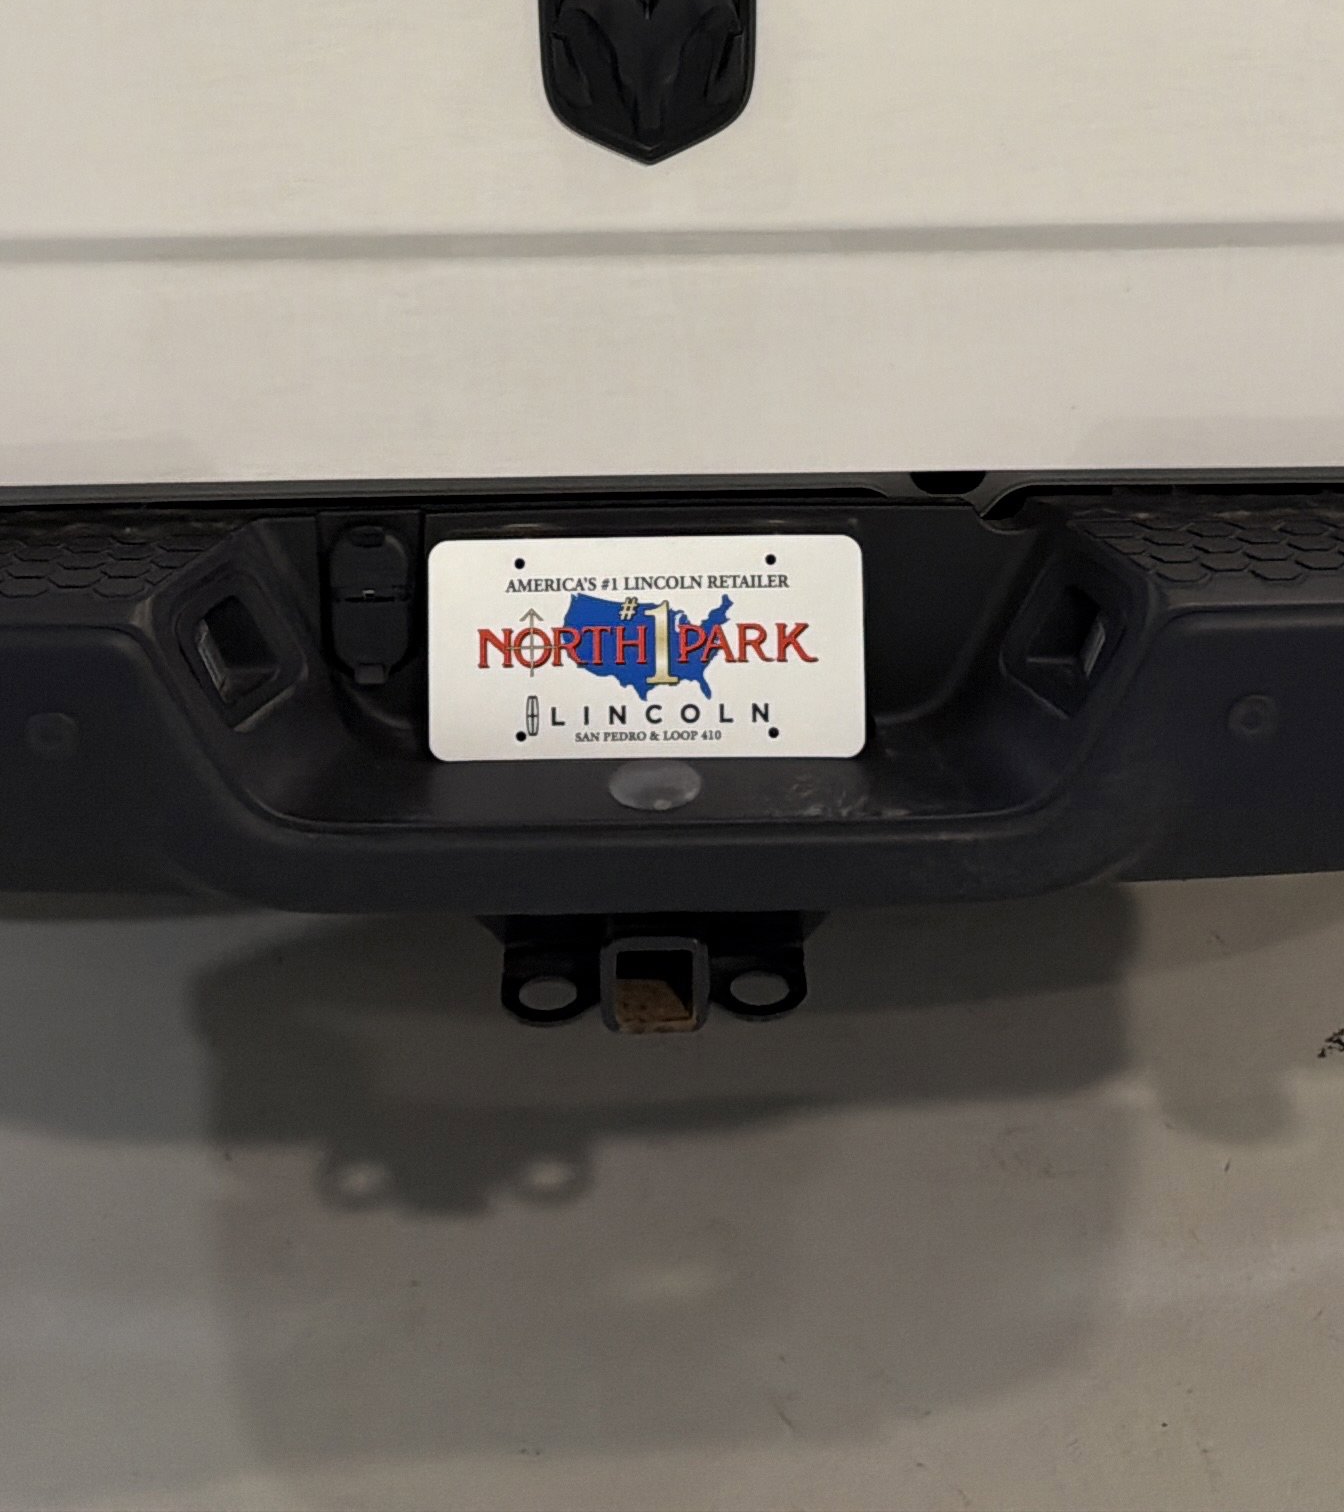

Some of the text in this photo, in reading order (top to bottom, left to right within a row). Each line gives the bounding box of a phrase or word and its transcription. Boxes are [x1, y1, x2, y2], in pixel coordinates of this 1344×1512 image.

[505, 574, 790, 593] AMERICA'S #1 LINCOLN RETAILER
[478, 622, 819, 669] NORTH PARK
[551, 703, 769, 726] LINCOLN
[575, 730, 722, 743] SAN PEDRO & LOOP 410
